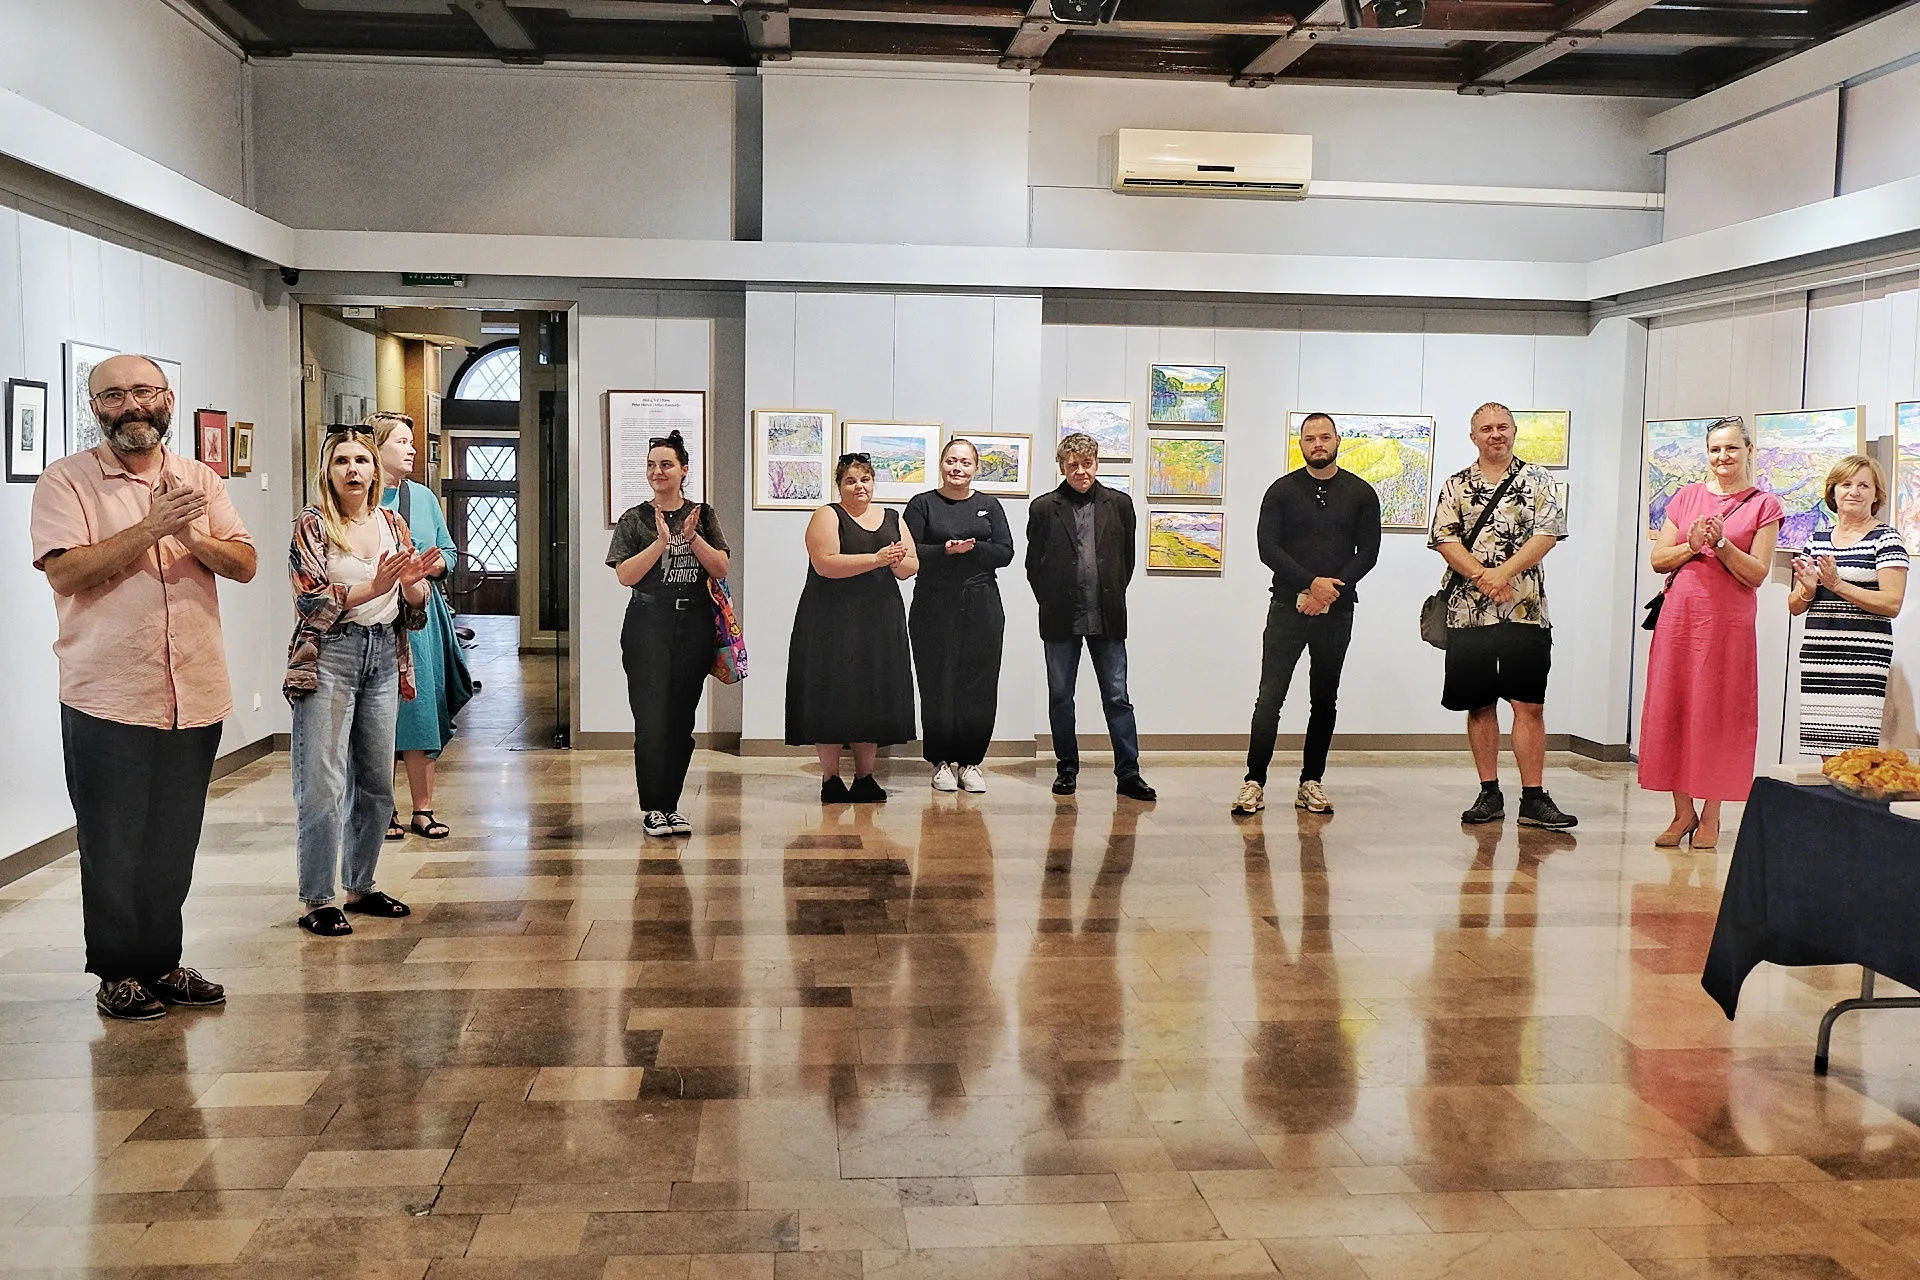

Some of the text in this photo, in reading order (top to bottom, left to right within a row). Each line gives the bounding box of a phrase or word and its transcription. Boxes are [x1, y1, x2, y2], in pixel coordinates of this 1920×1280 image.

[668, 533, 689, 545] DANC
[670, 544, 692, 555] THROU
[673, 556, 699, 568] LIGHTN
[668, 569, 698, 583] STRIKES
